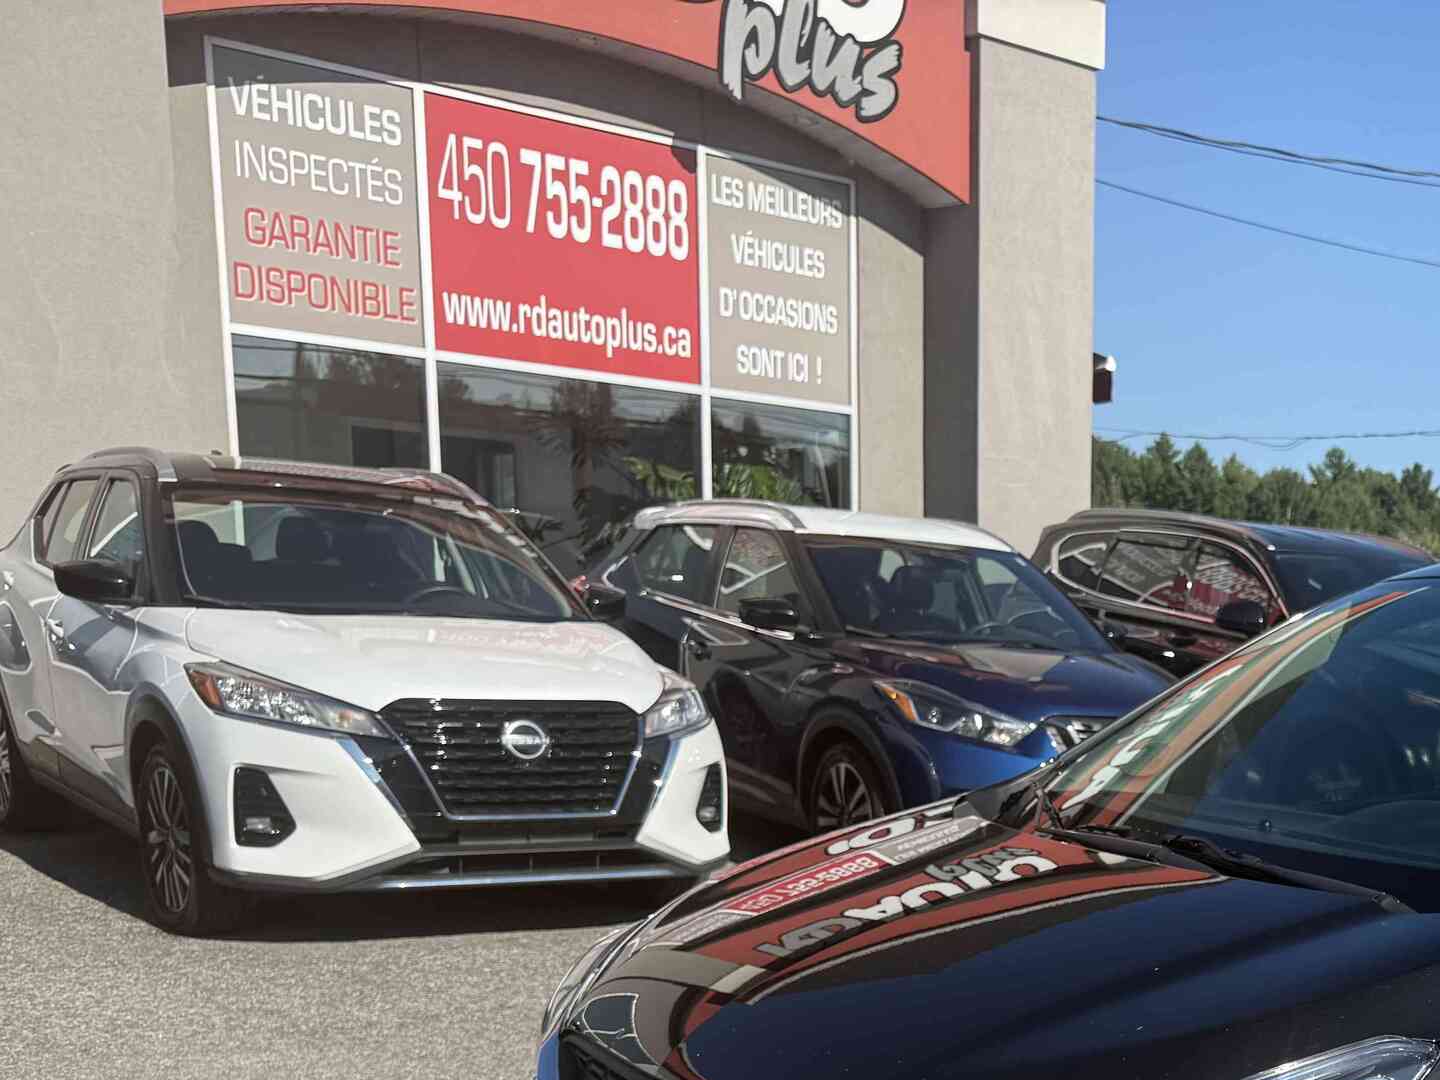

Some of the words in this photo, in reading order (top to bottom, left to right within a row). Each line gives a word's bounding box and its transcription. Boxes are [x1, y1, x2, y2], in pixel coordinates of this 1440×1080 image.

[721, 0, 901, 119] plus
[228, 75, 402, 146] VÉHICULES
[234, 139, 403, 205] INSPECTÉS
[437, 133, 511, 229] 450
[519, 148, 690, 262] 755-2888
[711, 173, 744, 209] LES
[747, 181, 842, 228] MEILLEURS
[244, 207, 402, 269] GARANTIE
[731, 230, 825, 278] VÉHICULES
[233, 261, 417, 324] DISPONIBLE
[442, 291, 692, 358] www.rdautoplus.ca
[736, 344, 784, 379] SONT
[787, 352, 809, 384] ICI
